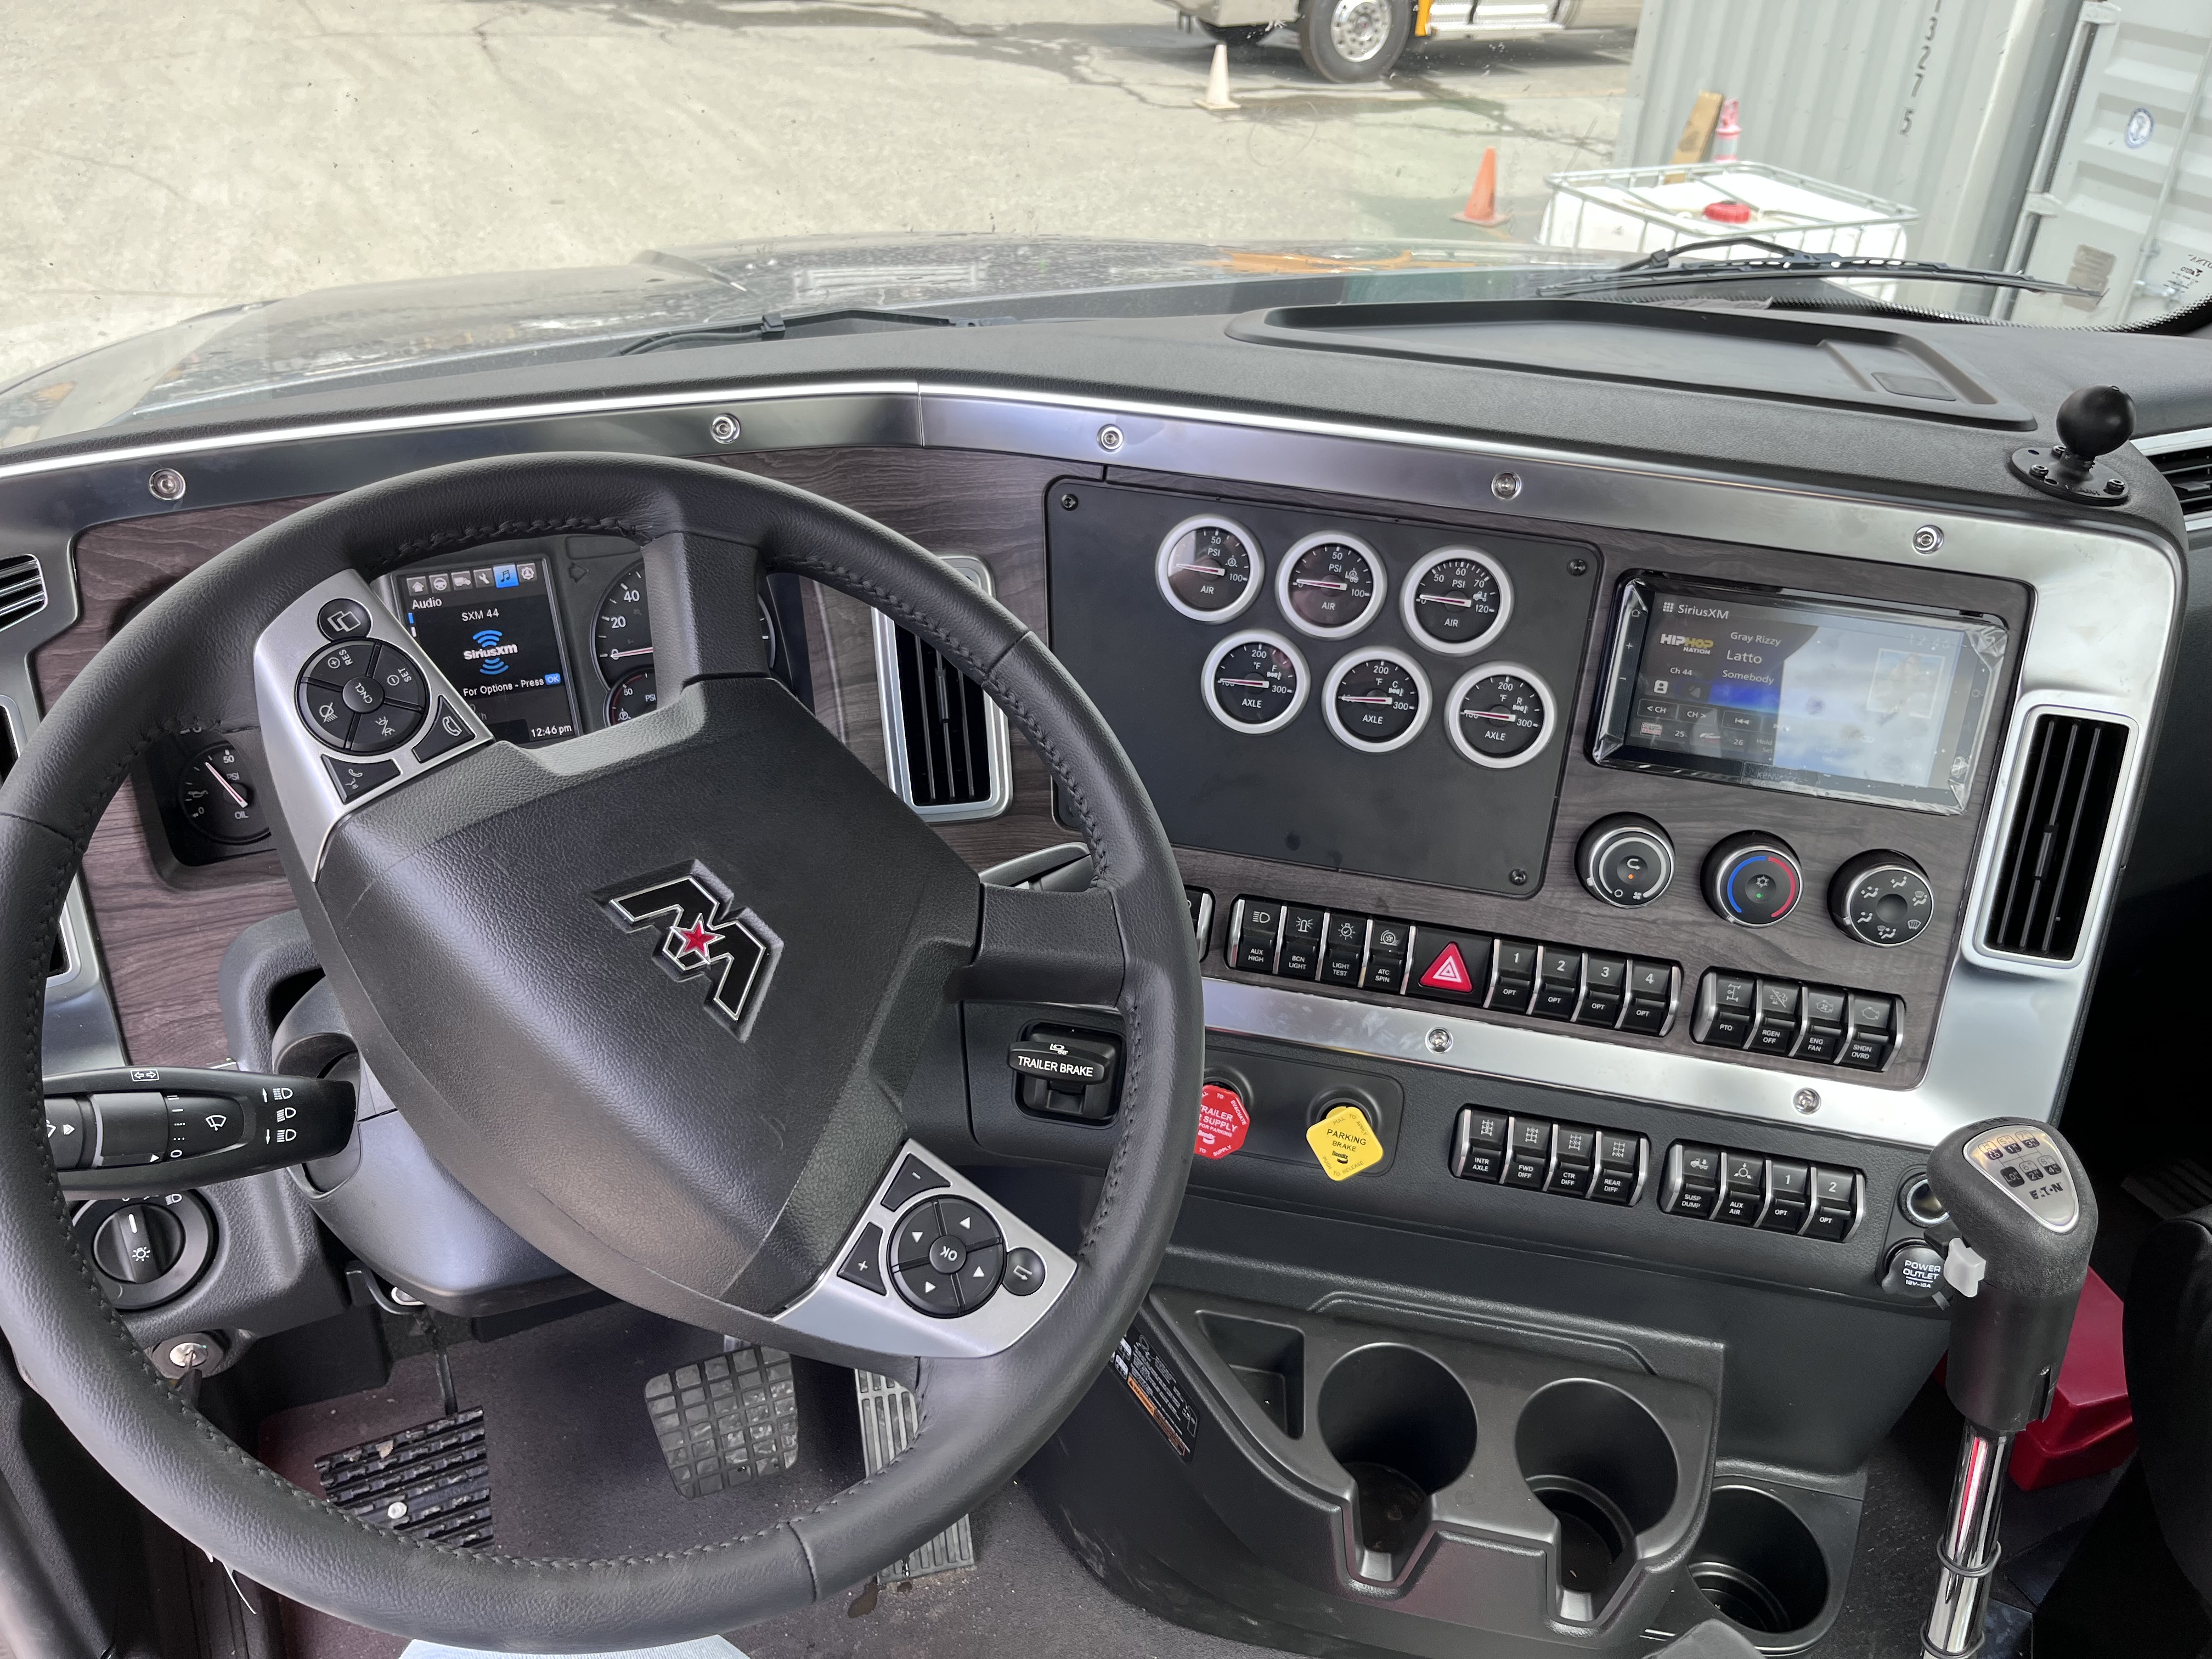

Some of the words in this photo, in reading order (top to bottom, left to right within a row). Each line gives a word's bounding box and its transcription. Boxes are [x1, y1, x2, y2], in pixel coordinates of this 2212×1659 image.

[1210, 536, 1222, 545] 50
[1207, 548, 1221, 557] PSI
[1331, 551, 1343, 560] 50
[1328, 563, 1342, 573] PSI
[1455, 567, 1466, 577] 60
[1229, 573, 1243, 582] 100
[1433, 573, 1444, 583] 50
[1451, 579, 1466, 589] PSI
[1473, 579, 1485, 588] 70
[1200, 585, 1214, 595] AIR
[1350, 589, 1365, 598] 100
[623, 589, 640, 603] 40
[411, 596, 442, 610] Audio
[1321, 601, 1335, 611] AIR
[1474, 604, 1489, 613] 120
[1677, 604, 1729, 620] SiriusXM
[461, 610, 484, 622] SXM
[486, 608, 499, 618] 44
[611, 616, 627, 629] 20
[1444, 618, 1459, 628] AIR
[1730, 631, 1754, 644] Gray
[1755, 635, 1781, 647] Rizzy
[1251, 649, 1267, 659] 200
[1683, 646, 1711, 655] NATION
[338, 649, 354, 666] RES
[1726, 650, 1763, 664] Latto
[1373, 665, 1389, 675] 200
[398, 668, 413, 684] SET
[1722, 669, 1775, 685] Somebody
[462, 688, 478, 697] For
[479, 682, 513, 696] Options
[521, 678, 544, 690] Press
[547, 674, 560, 684] OK
[1271, 685, 1287, 695] 300
[1497, 681, 1514, 691] 200
[354, 682, 373, 705] CNCL
[623, 688, 633, 697] 50
[645, 694, 656, 702] PSI
[1241, 698, 1262, 709] AXLE
[1392, 702, 1409, 711] 300
[1655, 706, 1667, 714] CH
[1686, 710, 1699, 719] CH
[1362, 714, 1383, 725] AXLE
[1516, 718, 1532, 728] 300
[531, 724, 557, 738] 12:46
[558, 725, 572, 735] pm
[1484, 730, 1506, 741] AXLE
[223, 755, 235, 764] 50
[234, 811, 249, 820] OIL
[1514, 952, 1519, 963] 1
[1288, 961, 1307, 970] LIGHT
[1332, 962, 1350, 970] LIGHT
[1556, 960, 1565, 972] 2
[1333, 969, 1348, 977] TEST
[1378, 968, 1390, 976] ATC
[1601, 966, 1609, 977] 3
[1375, 975, 1390, 983] SPIN
[1645, 973, 1654, 984] 4
[1636, 1009, 1650, 1017] OPT
[1762, 1029, 1781, 1038] RGEN
[1808, 1044, 1821, 1052] FAN
[1853, 1044, 1872, 1053] SHDN
[1851, 1051, 1870, 1059] OVRD
[1018, 1055, 1058, 1073] TRAILER
[1059, 1063, 1093, 1077] BRAKE
[1230, 1099, 1247, 1126] EVACUATE
[1203, 1115, 1238, 1132] SUPPLY
[1333, 1116, 1346, 1125] PULL
[1356, 1120, 1368, 1136] APPLY
[1210, 1126, 1233, 1137] PARKING
[1327, 1128, 1367, 1146] PARKING
[1212, 1144, 1232, 1156] SUPPLY
[1332, 1140, 1357, 1152] BRAKE
[1322, 1155, 1333, 1170] PUSH
[1342, 1160, 1364, 1174] RELEASE
[1472, 1164, 1488, 1172] AXLE
[1519, 1164, 1533, 1172] FWD
[1517, 1171, 1532, 1179] DIFF
[1785, 1175, 1791, 1185] 1
[1829, 1182, 1837, 1193] 2
[1681, 1200, 1701, 1209] DUMP
[1729, 1201, 1743, 1209] AUX
[1729, 1207, 1741, 1216] AIR
[1819, 1216, 1833, 1224] OPT
[940, 1245, 958, 1262] OK
[1904, 1260, 1941, 1272] POWER
[1903, 1268, 1939, 1280] OUTLET
